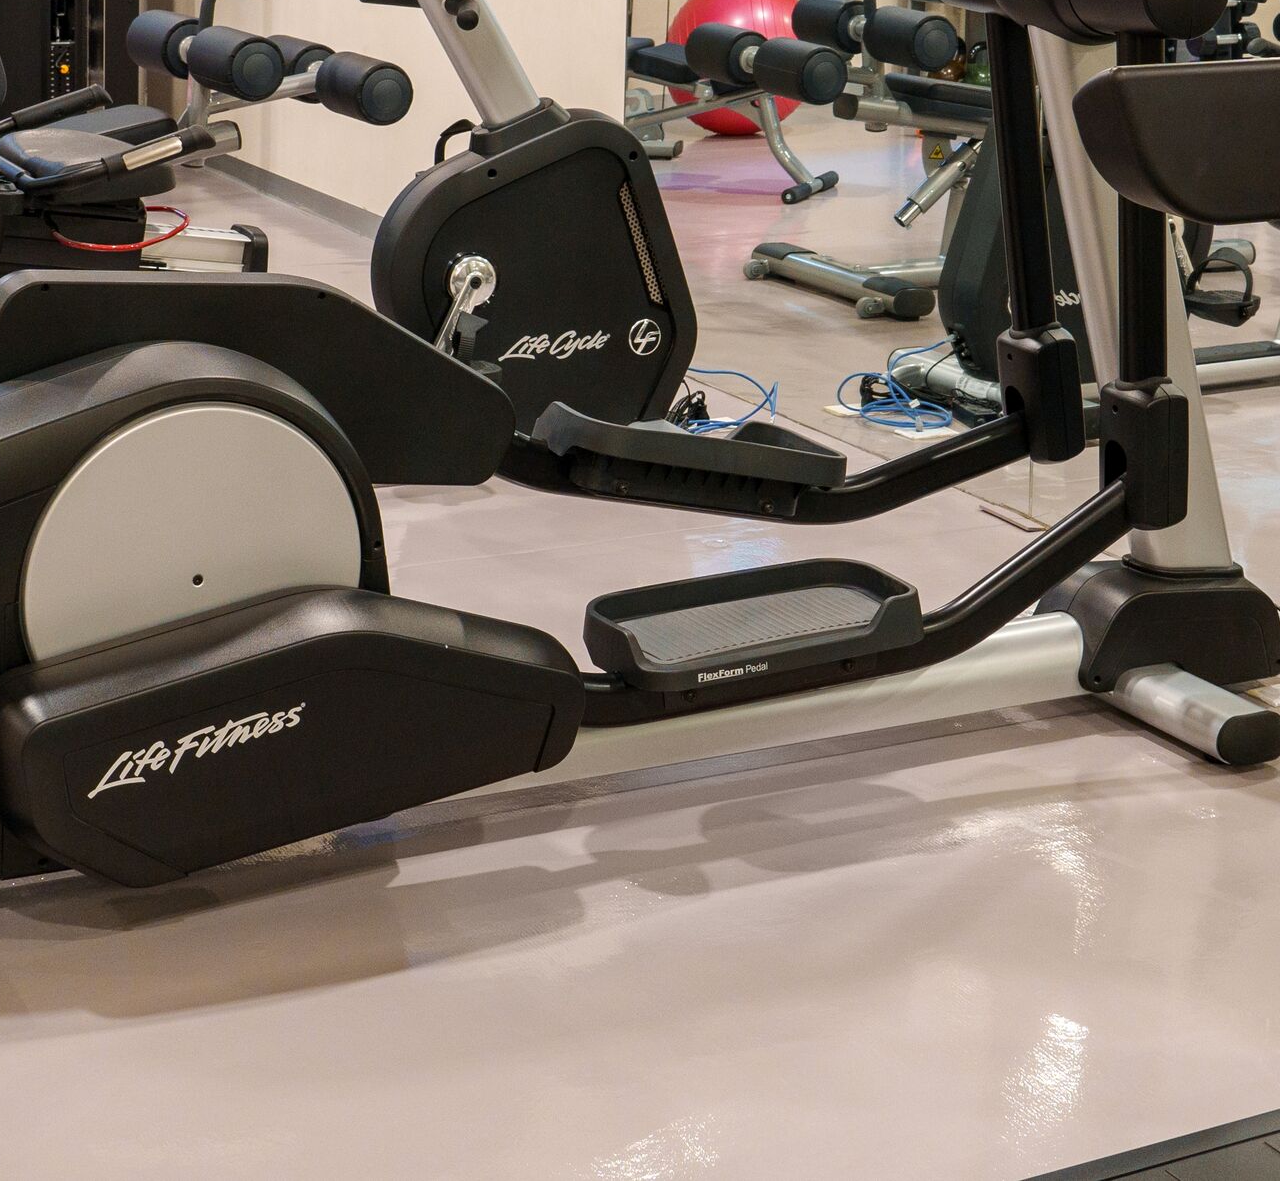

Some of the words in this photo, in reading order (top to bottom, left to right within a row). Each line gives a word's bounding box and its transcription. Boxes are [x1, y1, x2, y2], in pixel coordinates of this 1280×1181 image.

[498, 333, 551, 362] Life
[549, 329, 608, 360] Cycle
[697, 667, 744, 683] FlexForm
[745, 661, 769, 674] Pedal
[87, 740, 171, 800] Life
[169, 705, 304, 775] Fitness
